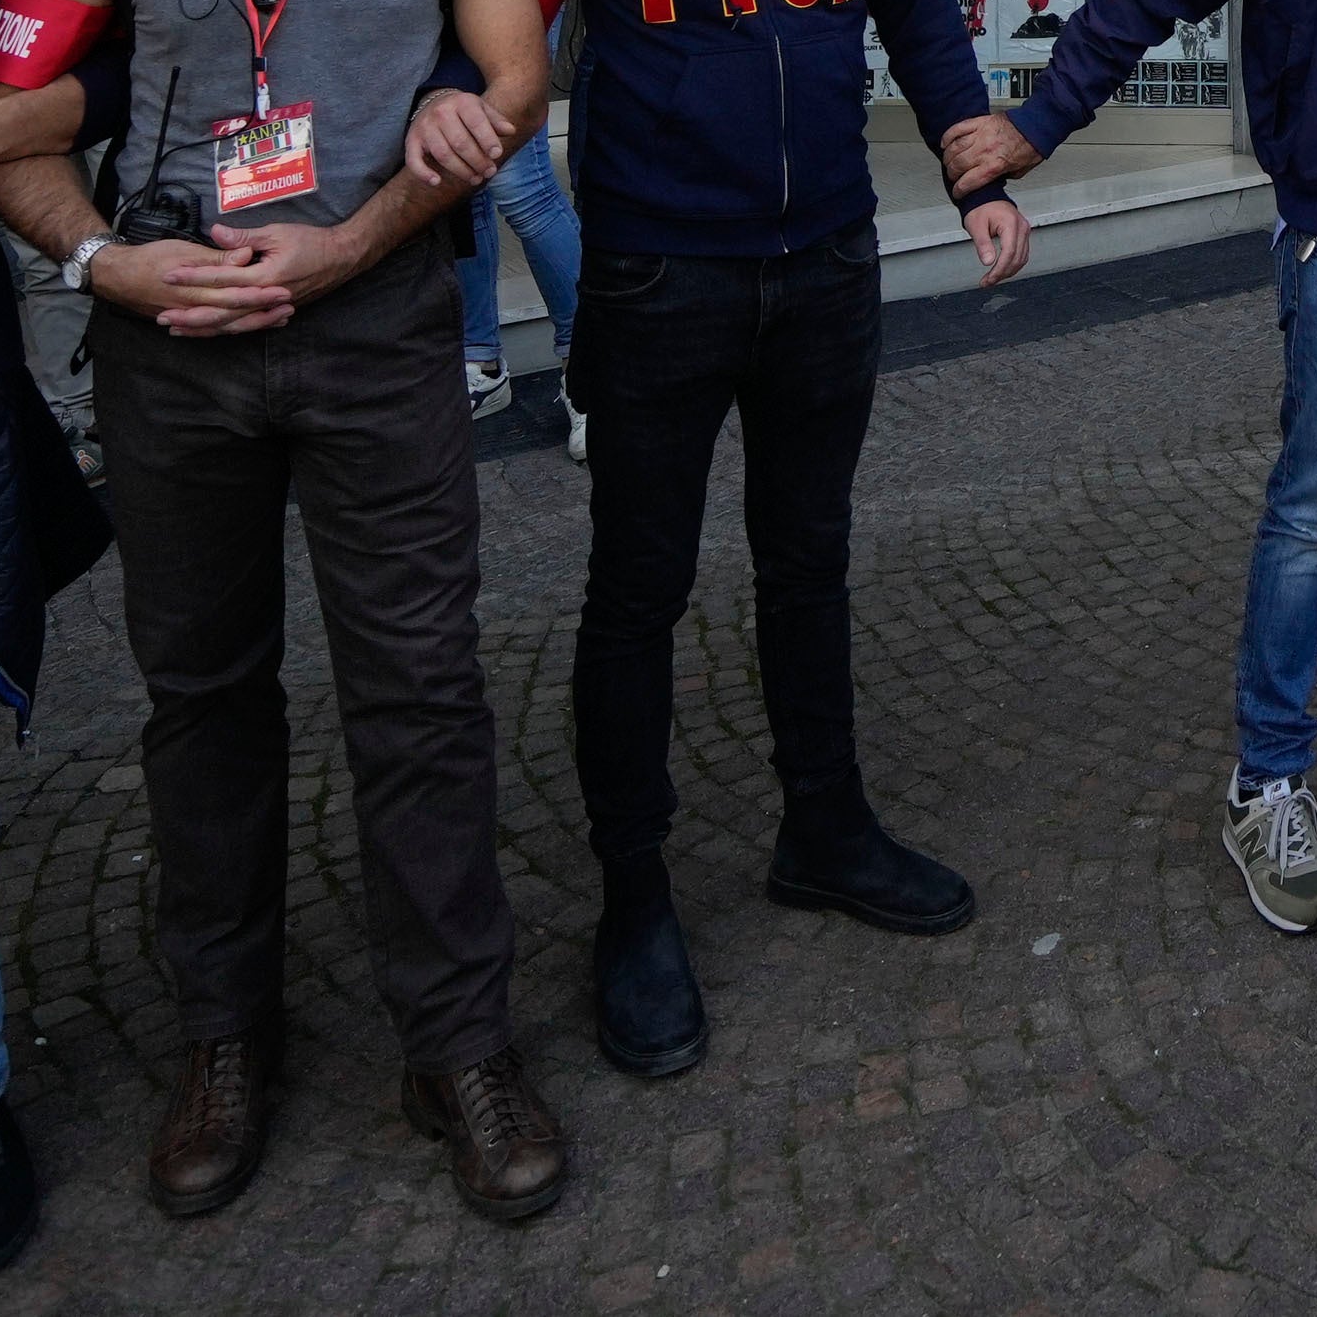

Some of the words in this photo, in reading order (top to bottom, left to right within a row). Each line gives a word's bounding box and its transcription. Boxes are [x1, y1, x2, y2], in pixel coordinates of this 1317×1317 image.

[969, 26, 987, 37] no
[249, 121, 290, 143] A.N.P.I.
[226, 171, 305, 201] ORGANIZZAZIONE
